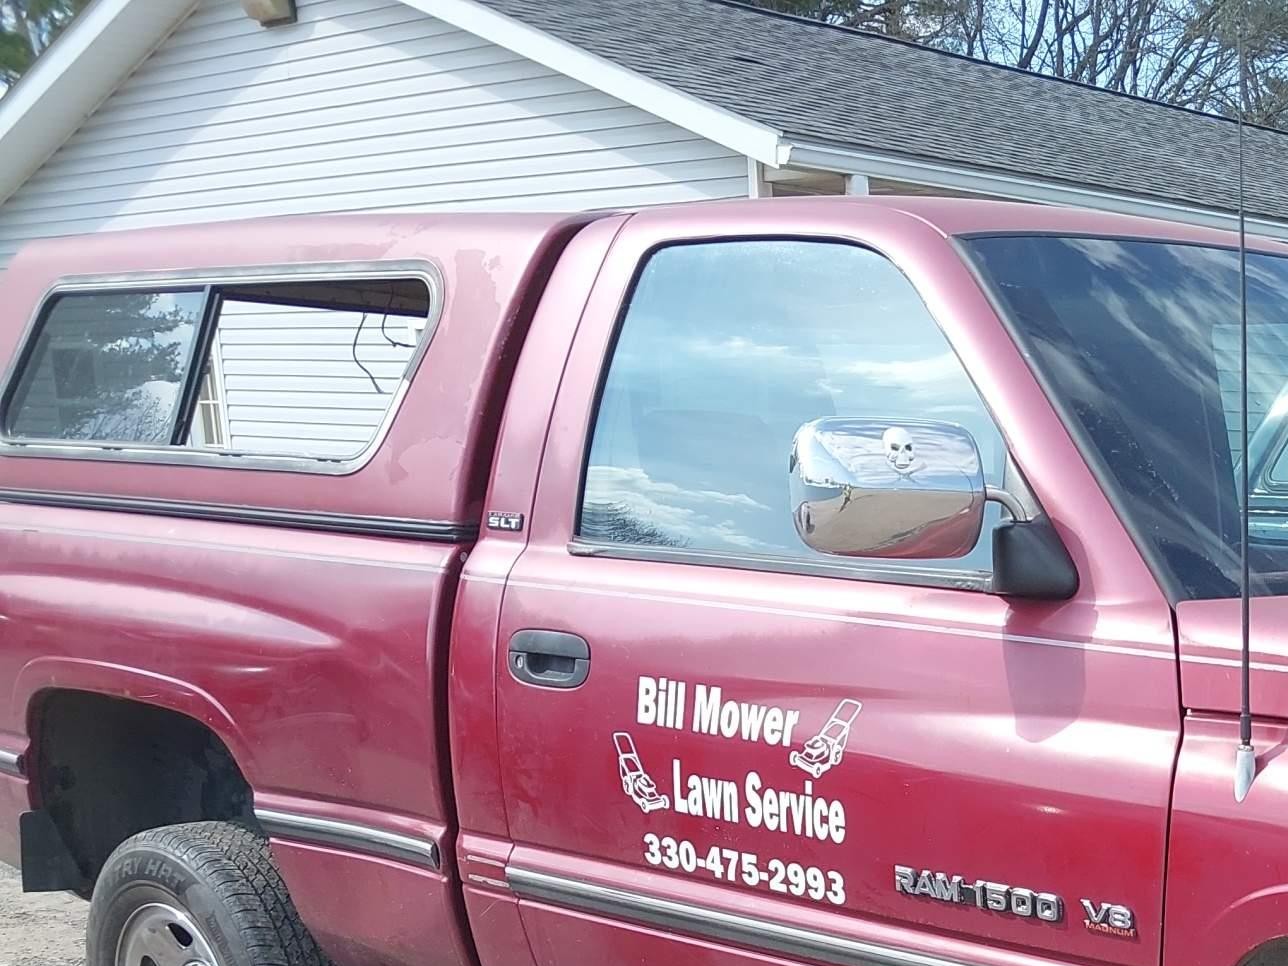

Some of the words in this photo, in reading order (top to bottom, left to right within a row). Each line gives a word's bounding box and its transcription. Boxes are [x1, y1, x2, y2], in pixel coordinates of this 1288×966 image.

[488, 516, 521, 529] SLT
[637, 676, 686, 730] Bill
[692, 684, 799, 747] Mower
[673, 759, 738, 823] Lawn
[745, 771, 845, 844] Service
[643, 833, 846, 904] 330-475-2993
[1080, 898, 1131, 929] V8
